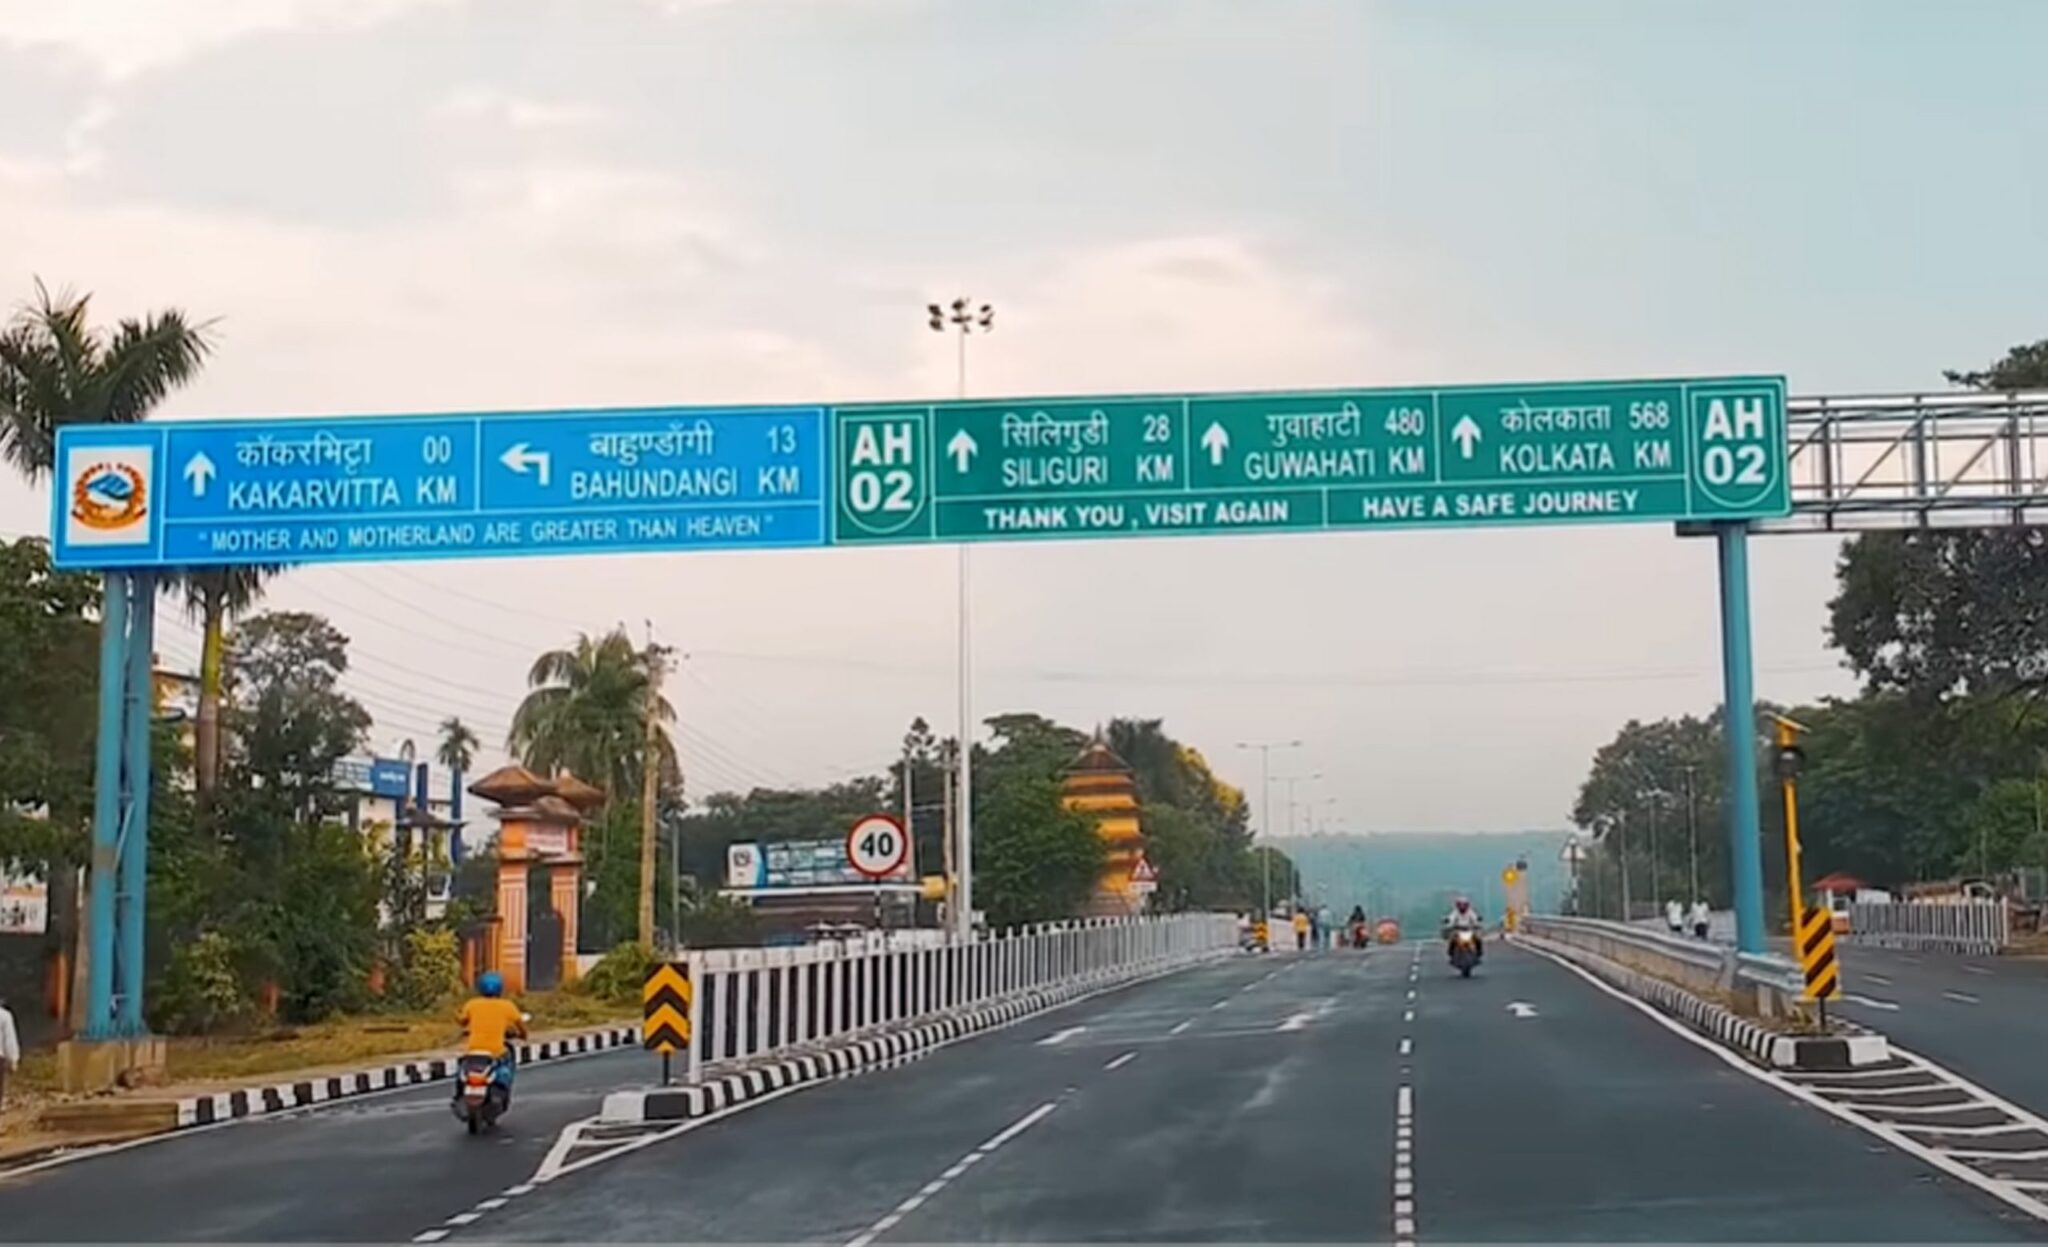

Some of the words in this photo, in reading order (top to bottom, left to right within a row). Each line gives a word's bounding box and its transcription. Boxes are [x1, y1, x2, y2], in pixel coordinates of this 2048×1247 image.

[1143, 414, 1170, 442] 28
[1266, 401, 1361, 447] गुवाहाटी
[1385, 407, 1425, 436] 480
[1500, 399, 1611, 433] कोलकाता
[1629, 401, 1670, 430] 568
[1704, 399, 1765, 441] AH
[423, 436, 451, 464] 00
[768, 427, 796, 453] 13
[851, 425, 912, 465] AH
[1500, 442, 1615, 473] KOLKATA
[1633, 439, 1672, 469] KM
[1002, 456, 1108, 487] SILIGURI
[1136, 454, 1174, 483] KM
[1244, 449, 1376, 480] GUWAHATI
[1388, 447, 1425, 475] KM
[1703, 445, 1767, 486] 02
[228, 477, 400, 509] KAKARVITTA
[417, 477, 457, 505] KM
[570, 467, 738, 499] BAHUNDANGI
[759, 465, 799, 494] KM
[849, 471, 914, 512] 02
[985, 507, 1068, 530] THANK
[1076, 505, 1125, 527] YOU
[1145, 503, 1207, 526] VISIT
[1214, 500, 1289, 524] AGAIN
[1363, 495, 1426, 519] HAVE
[1433, 494, 1449, 516] A
[1456, 491, 1515, 516] SAFE
[1523, 489, 1639, 514] JOURNEY
[300, 527, 339, 549] AND
[349, 523, 475, 547] MOTHERLAND
[484, 521, 521, 543] ARE
[531, 518, 618, 541] GREATER
[627, 517, 677, 538] THAN
[860, 832, 895, 858] 40
